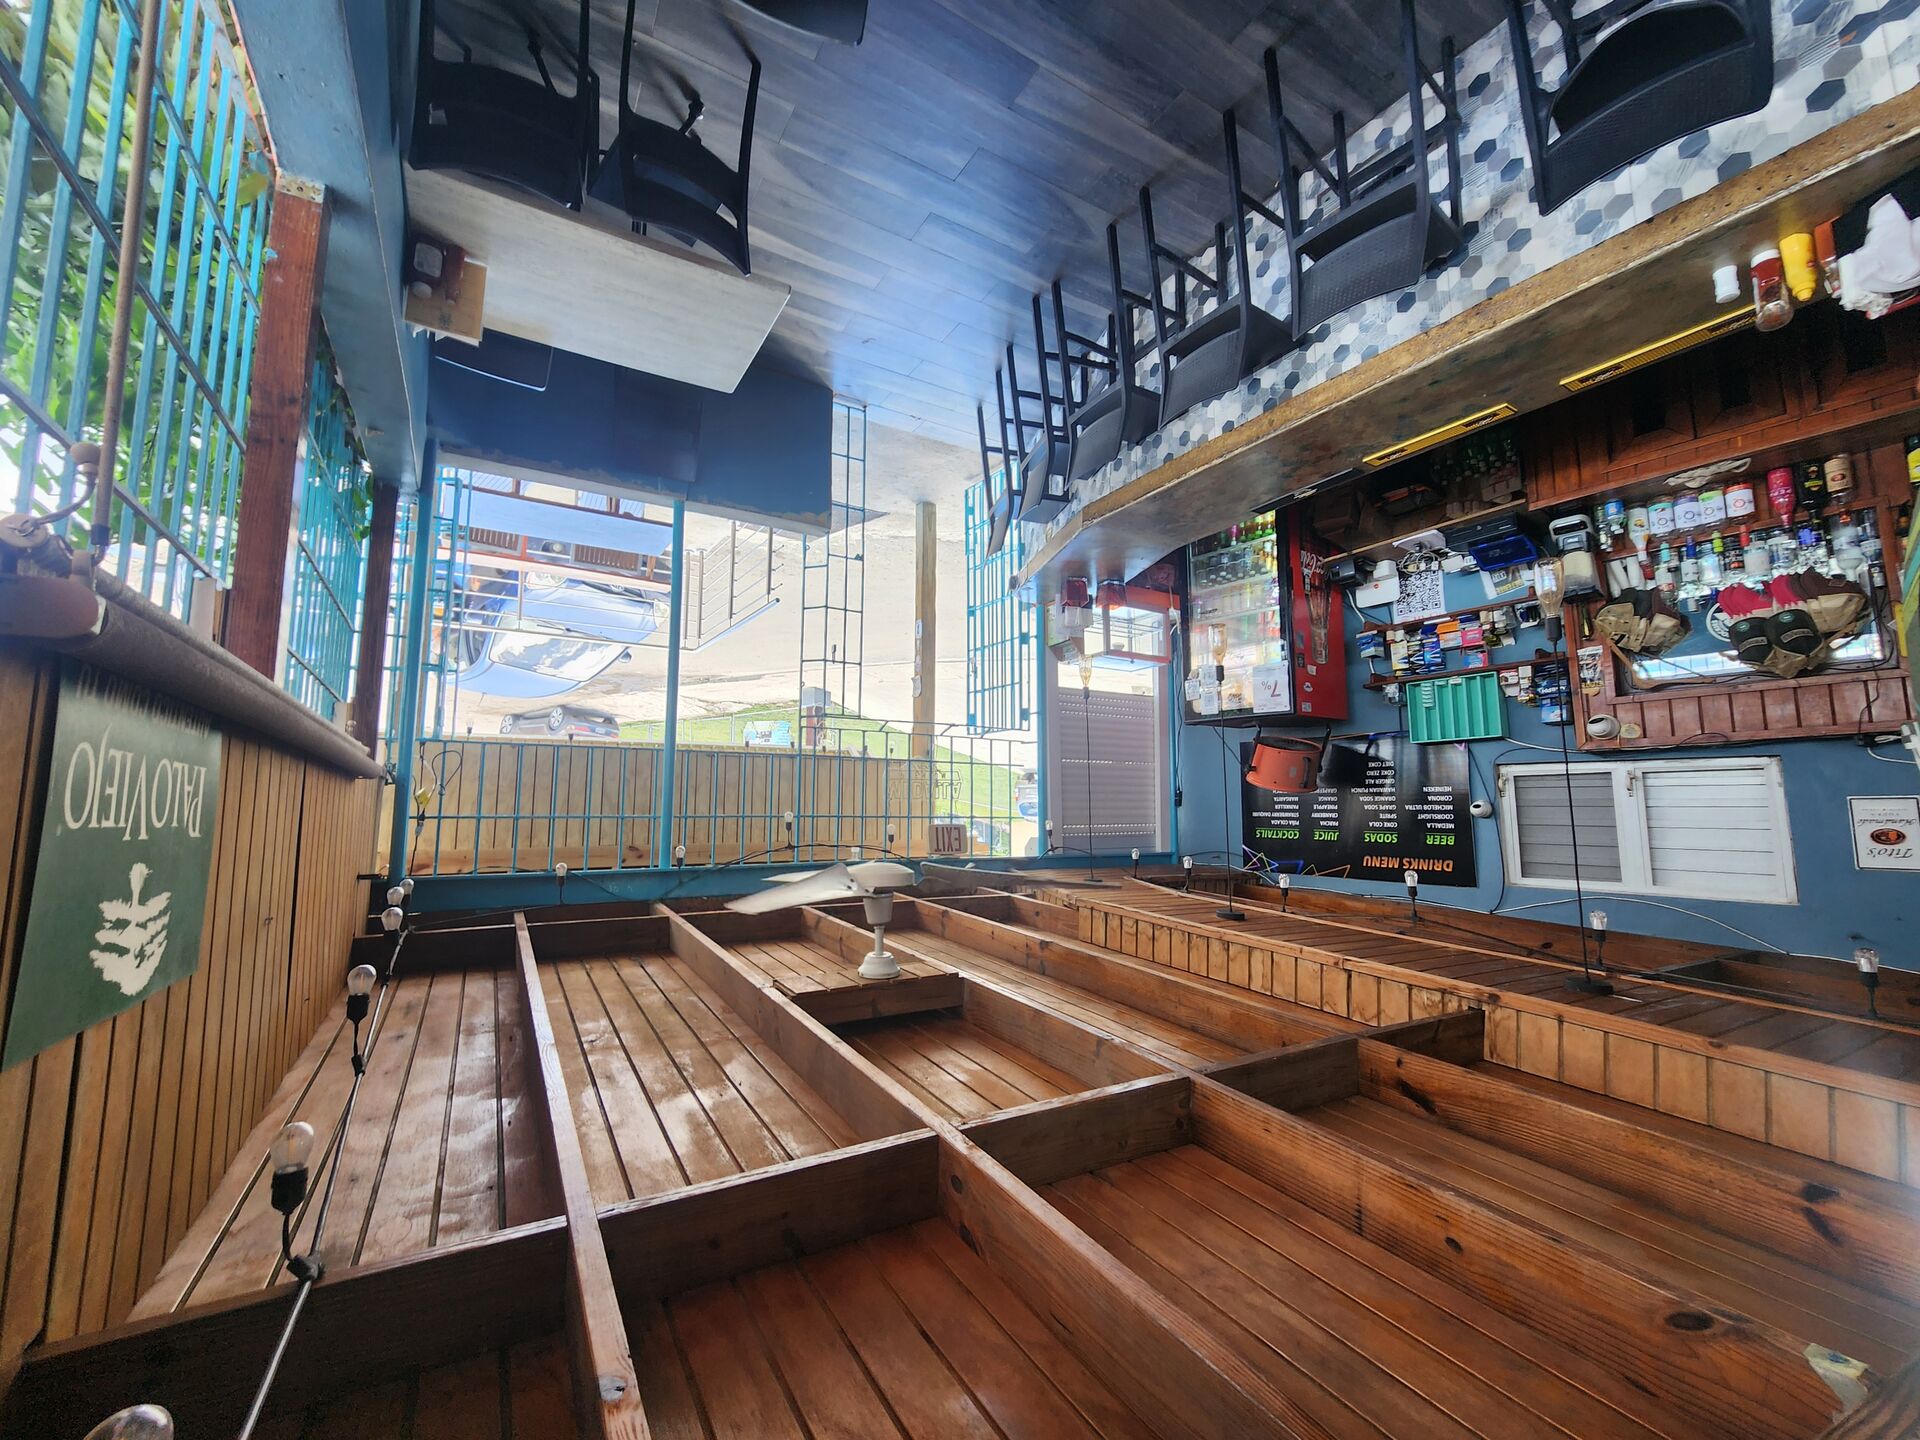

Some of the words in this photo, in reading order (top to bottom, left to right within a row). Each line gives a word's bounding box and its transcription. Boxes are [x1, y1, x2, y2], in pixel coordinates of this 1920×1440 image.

[934, 826, 962, 852] EXIT
[1256, 830, 1300, 839] COCKTAILS
[1314, 832, 1339, 841] JUICE
[1364, 833, 1398, 843] SODAS
[1426, 834, 1455, 846] BEER
[1867, 848, 1913, 859] Tito's
[1362, 855, 1400, 869] MENU
[1402, 857, 1454, 872] DRINKS
